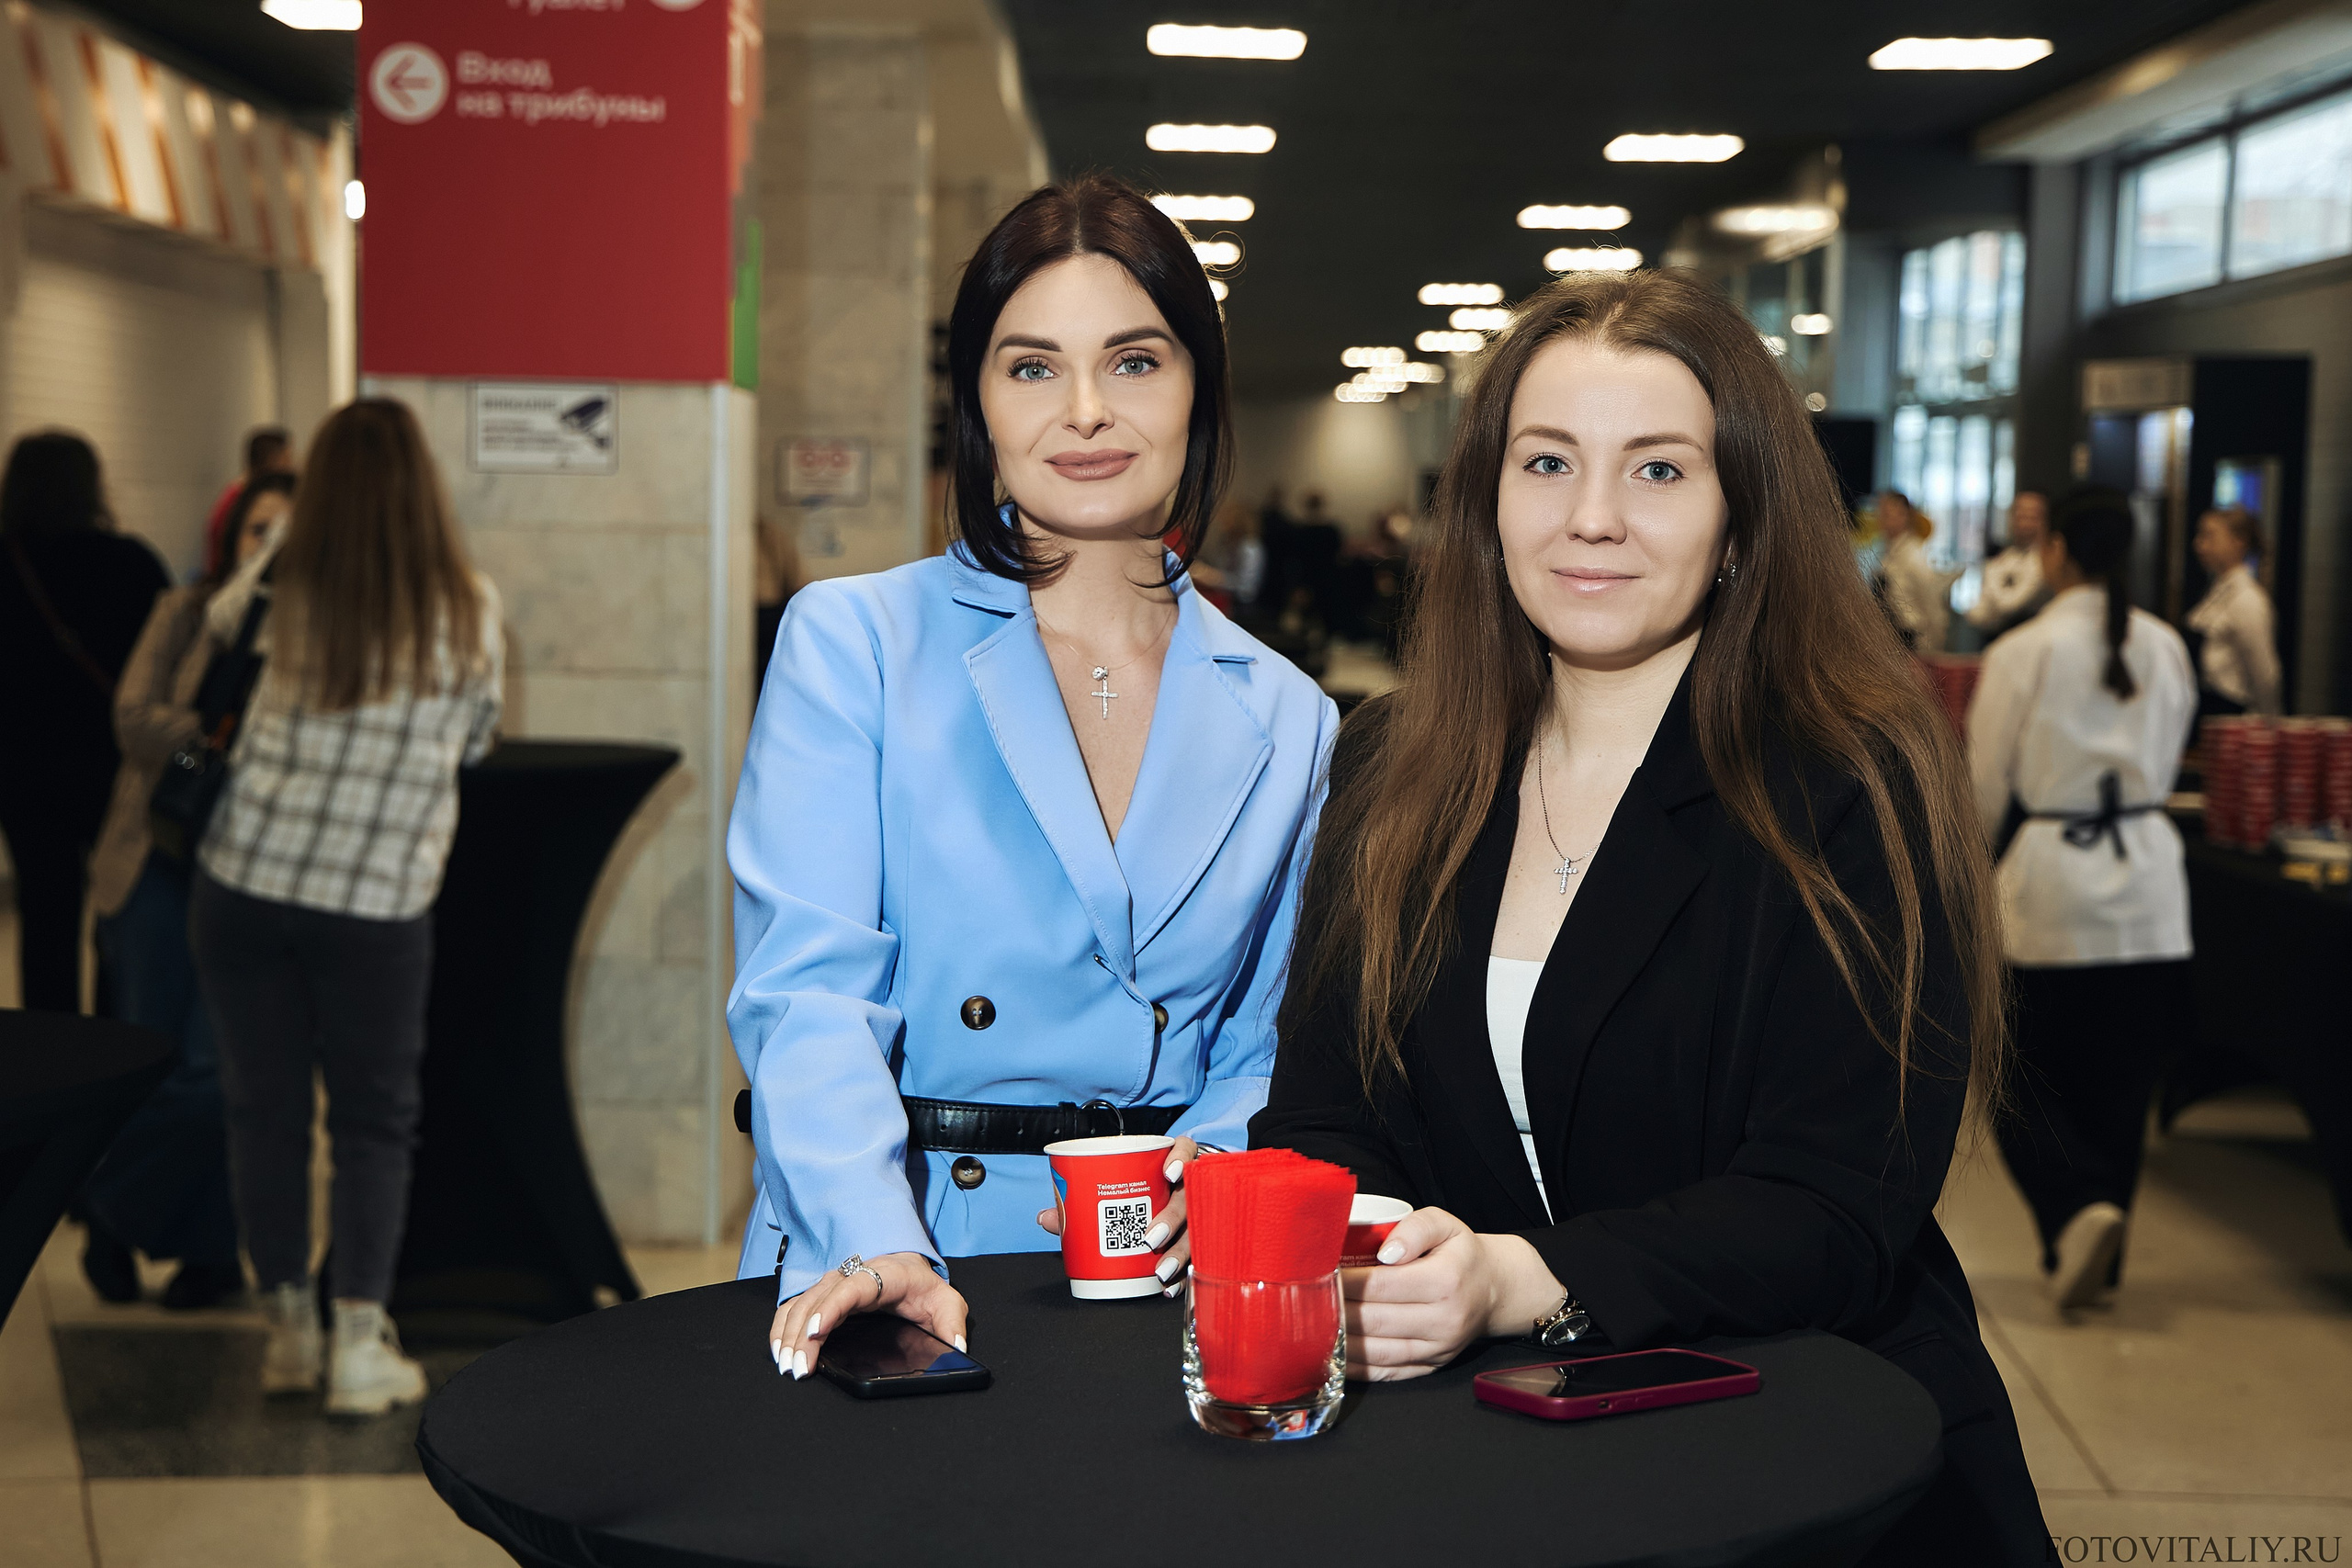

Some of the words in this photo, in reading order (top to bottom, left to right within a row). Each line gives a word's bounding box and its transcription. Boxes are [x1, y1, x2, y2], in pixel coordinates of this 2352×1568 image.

[458, 51, 552, 86] Вход
[458, 95, 503, 118] на
[509, 88, 666, 126] трибуны
